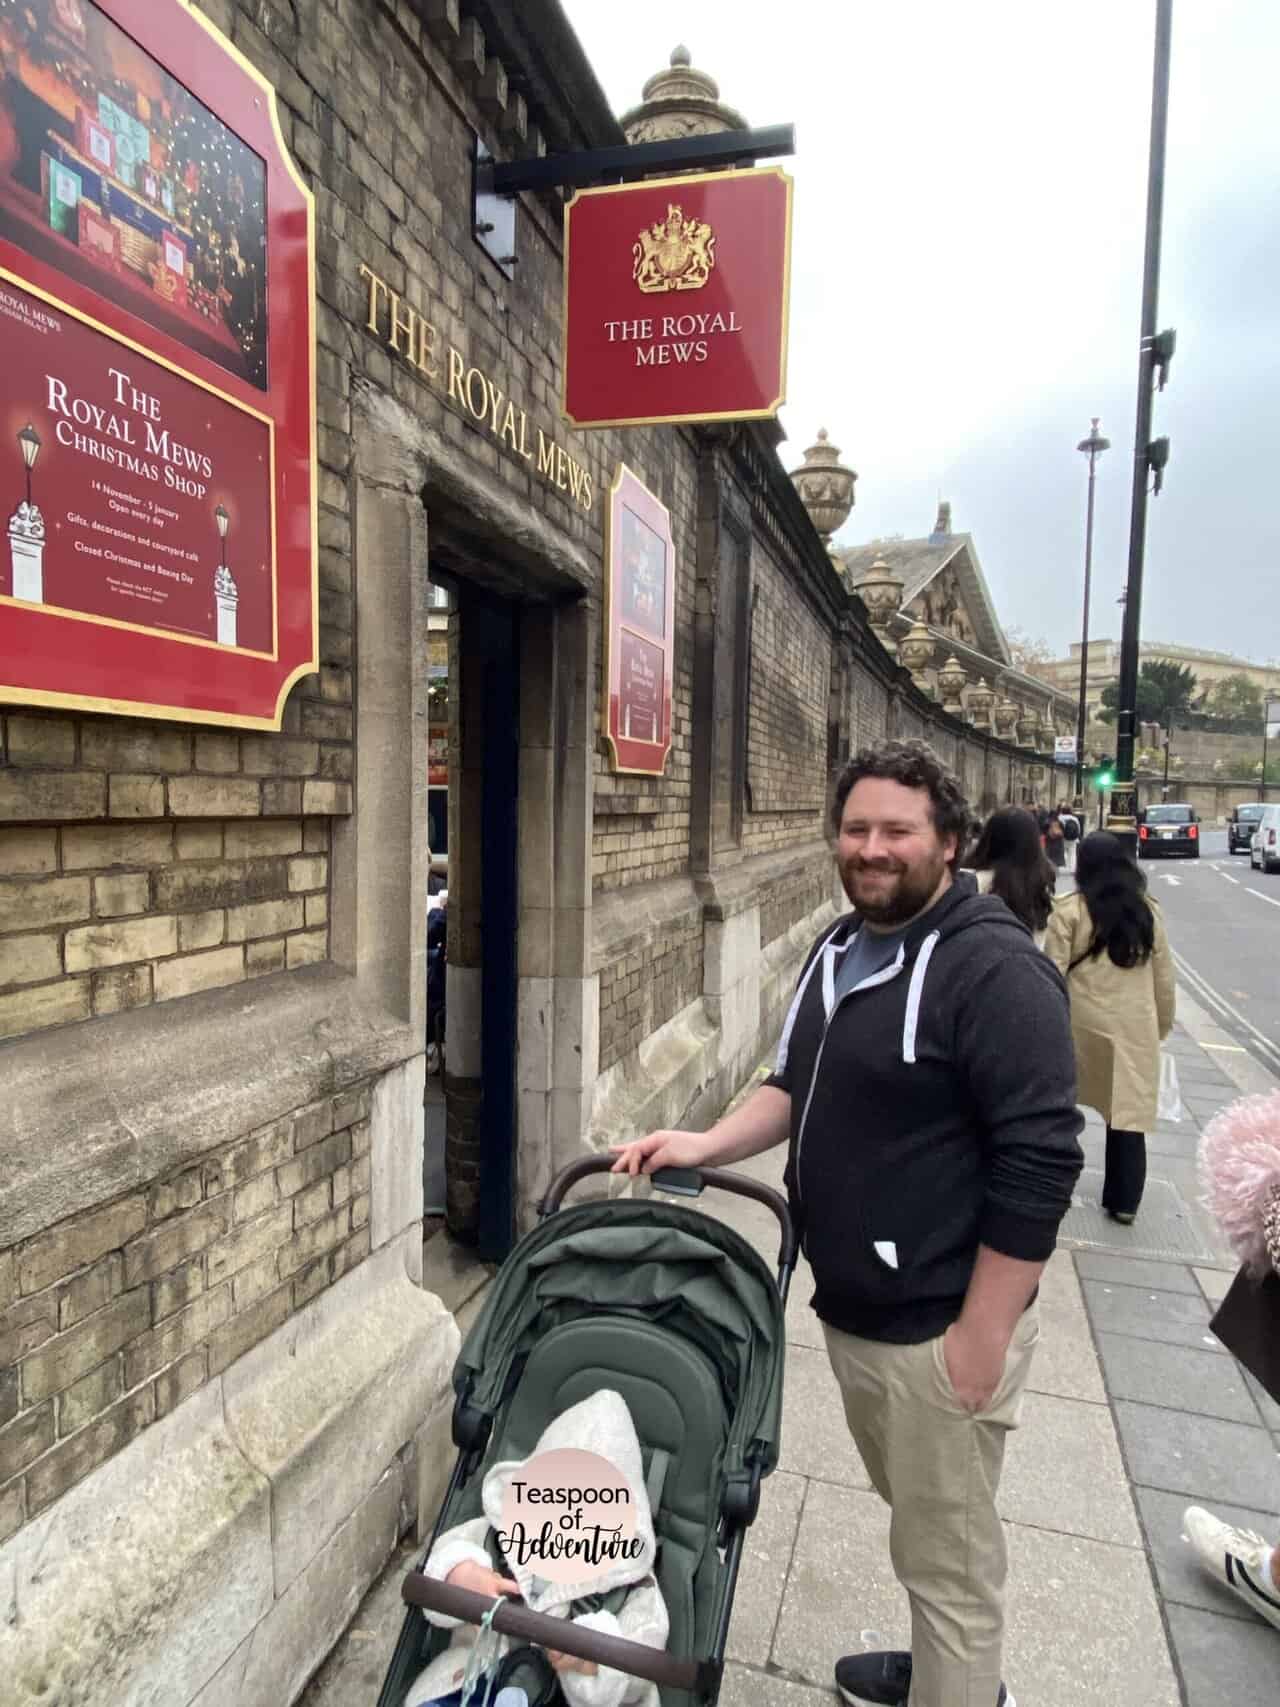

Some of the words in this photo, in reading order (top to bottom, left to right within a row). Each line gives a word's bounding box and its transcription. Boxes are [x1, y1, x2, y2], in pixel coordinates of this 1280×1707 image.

[604, 319, 653, 342] THE
[661, 311, 743, 337] ROYAL
[635, 341, 709, 366] MEWS
[108, 367, 162, 422] THE
[359, 263, 437, 378] THE
[448, 346, 532, 460] ROYAL
[537, 430, 592, 510] MEWS
[45, 374, 136, 445] ROYAL
[144, 420, 213, 478] MEWS
[56, 420, 159, 481] CHRISTMAS
[164, 465, 206, 499] SHOP
[102, 484, 142, 505] November
[108, 499, 130, 515] Open
[131, 509, 150, 524] every
[91, 520, 136, 542] decorations
[74, 541, 102, 557] Closed
[103, 550, 142, 569] Christmas
[143, 562, 156, 573] and
[157, 564, 180, 582] Boxing
[180, 572, 194, 585] Day
